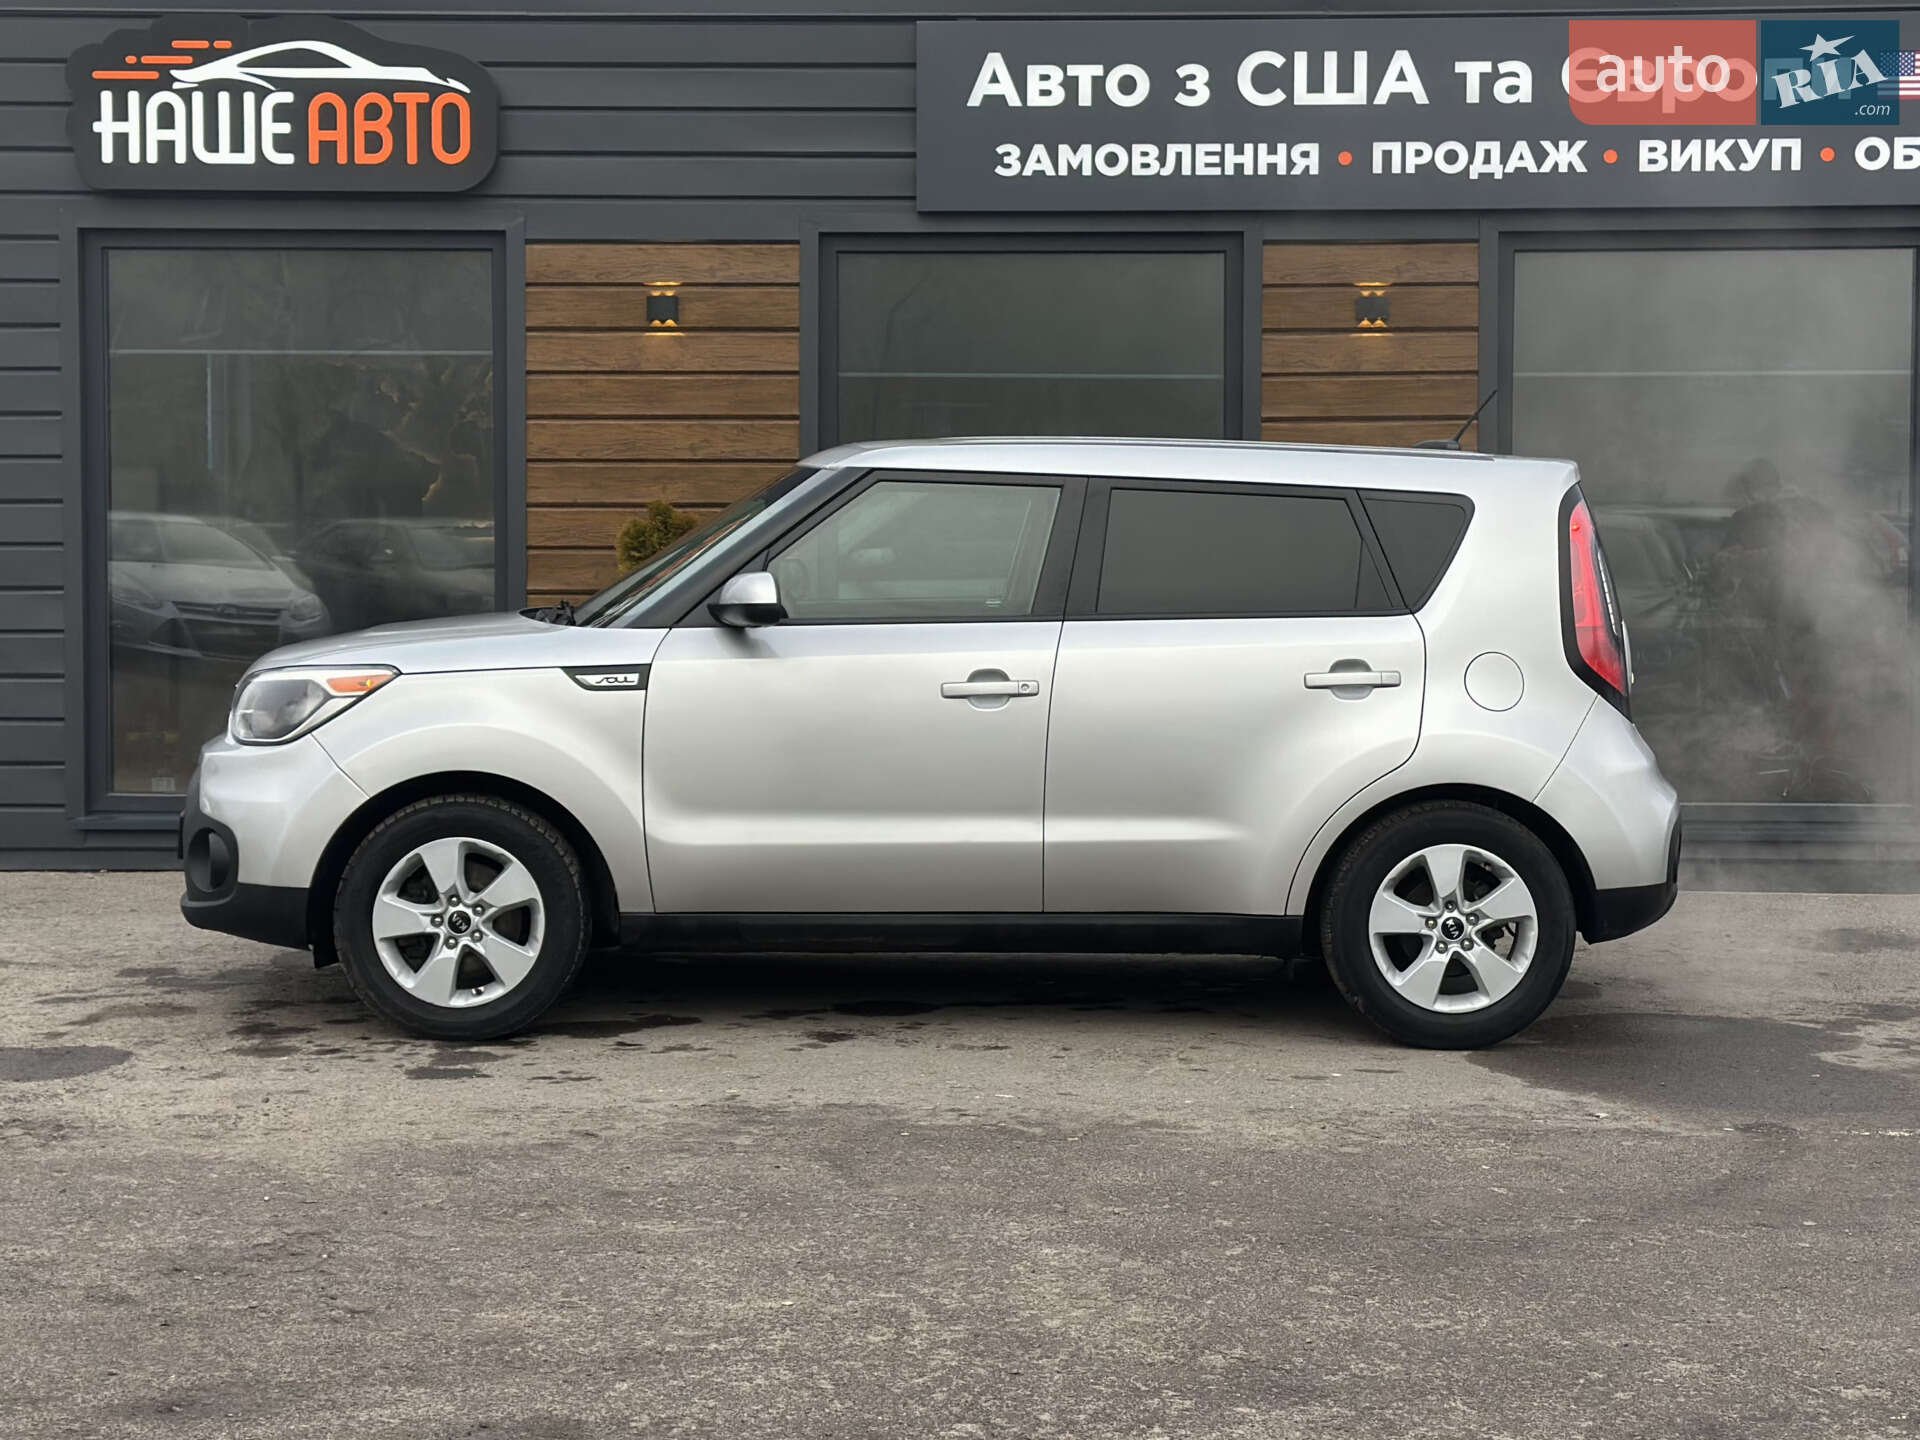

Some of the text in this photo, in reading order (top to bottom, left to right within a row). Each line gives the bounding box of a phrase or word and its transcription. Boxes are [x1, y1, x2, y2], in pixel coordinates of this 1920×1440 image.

[966, 52, 1151, 108] Авто
[1237, 49, 1430, 107] США
[1454, 60, 1533, 104] та
[92, 90, 471, 165] НАШЕ АВТО
[994, 142, 1320, 177] ЗАМОВЛЕННЯ
[1372, 139, 1588, 180] ПРОДАЖ
[1638, 137, 1802, 173] ВИКУП
